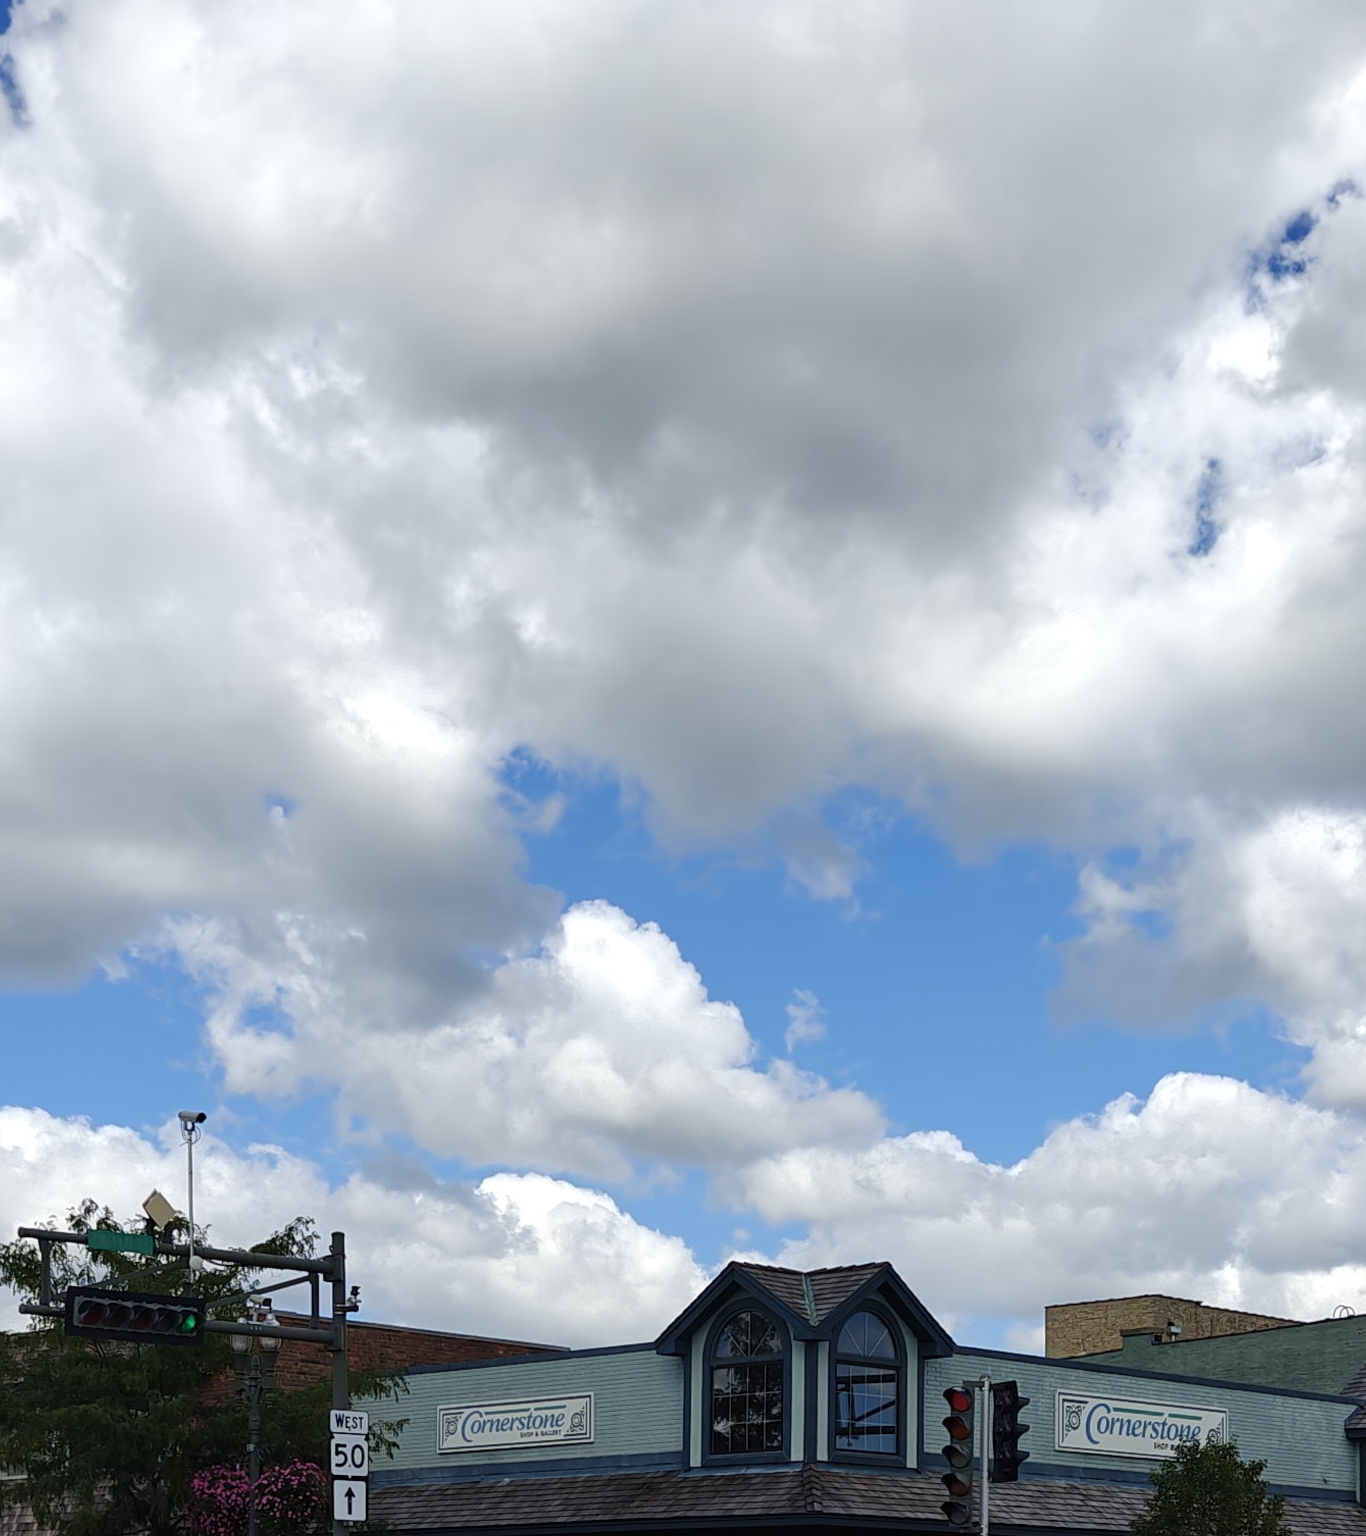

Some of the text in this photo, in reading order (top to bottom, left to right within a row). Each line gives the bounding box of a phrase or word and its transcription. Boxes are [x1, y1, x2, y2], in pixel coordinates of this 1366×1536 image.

[335, 1413, 364, 1430] WEST
[461, 1410, 566, 1443] Cornerstone
[1085, 1403, 1202, 1445] Cornerstone
[335, 1443, 365, 1469] 50
[1153, 1442, 1169, 1450] SHOP
